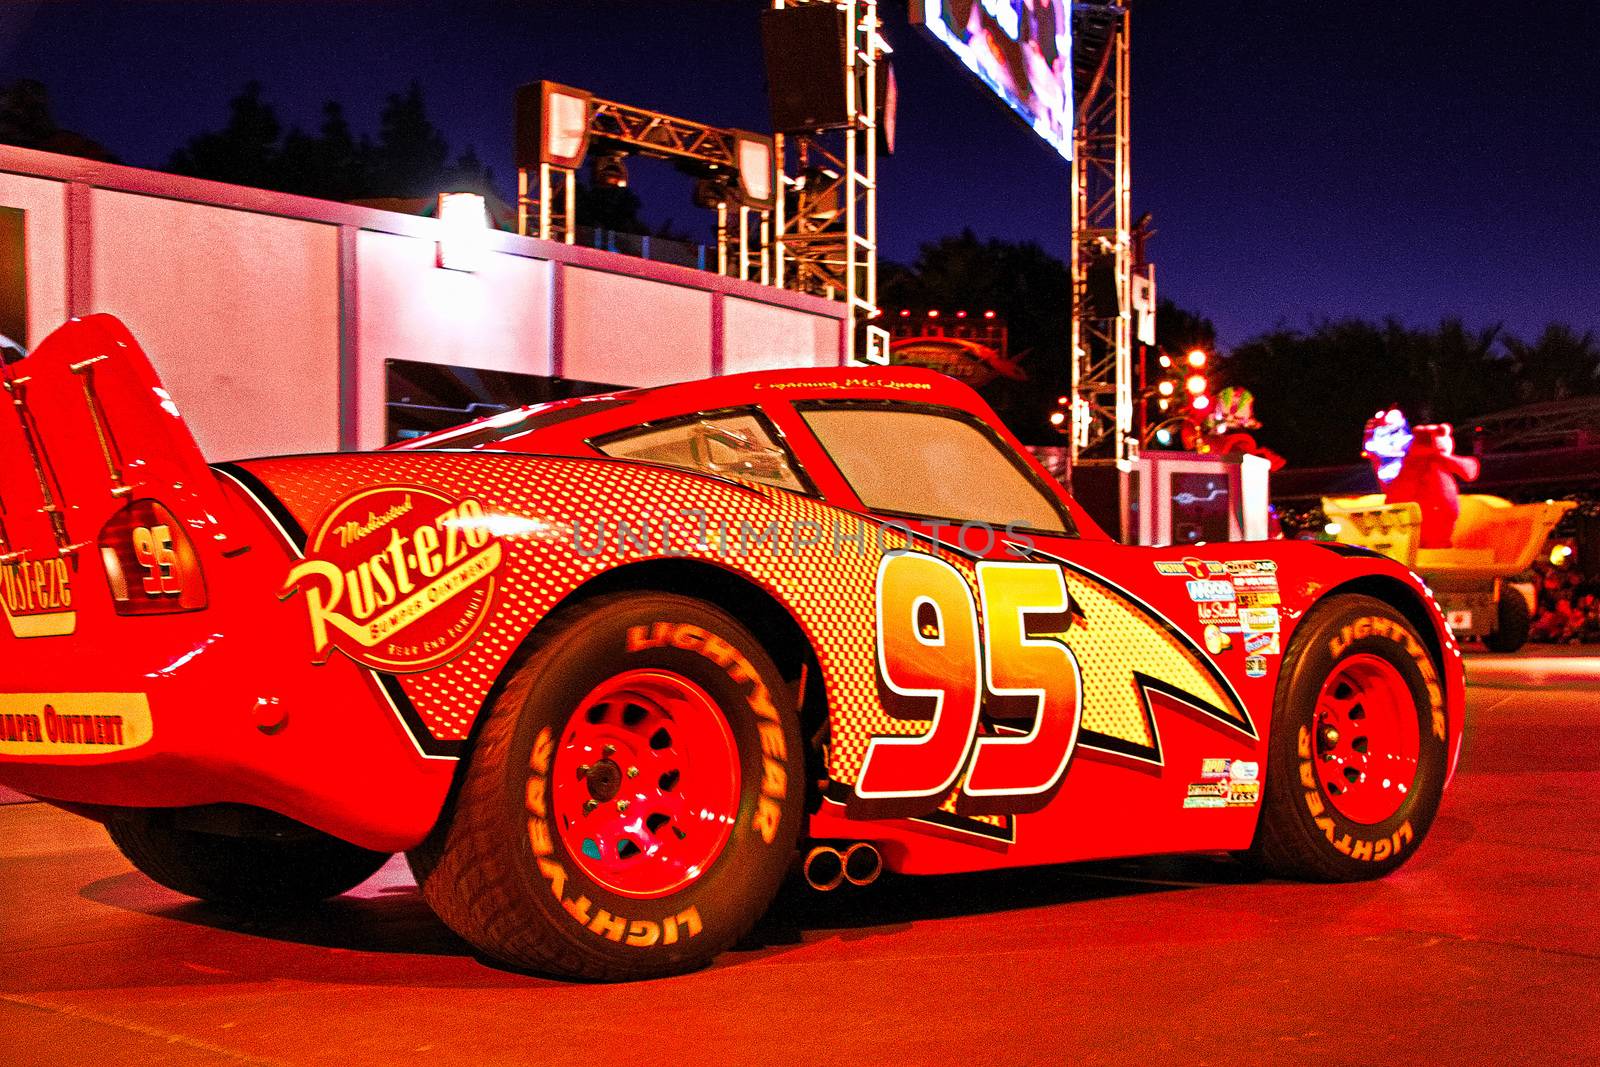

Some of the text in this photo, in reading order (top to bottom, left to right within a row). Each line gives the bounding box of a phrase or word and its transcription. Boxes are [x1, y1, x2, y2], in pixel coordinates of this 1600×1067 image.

[132, 524, 183, 595] 95
[44, 703, 124, 745] OINTMENT
[625, 620, 789, 845] LIGHTYEAR
[854, 549, 1084, 800] 95
[1328, 615, 1446, 743] LIGHTYEAR
[525, 726, 704, 948] LIGHTYEAR
[1297, 724, 1414, 862] LIGHTYEAR
